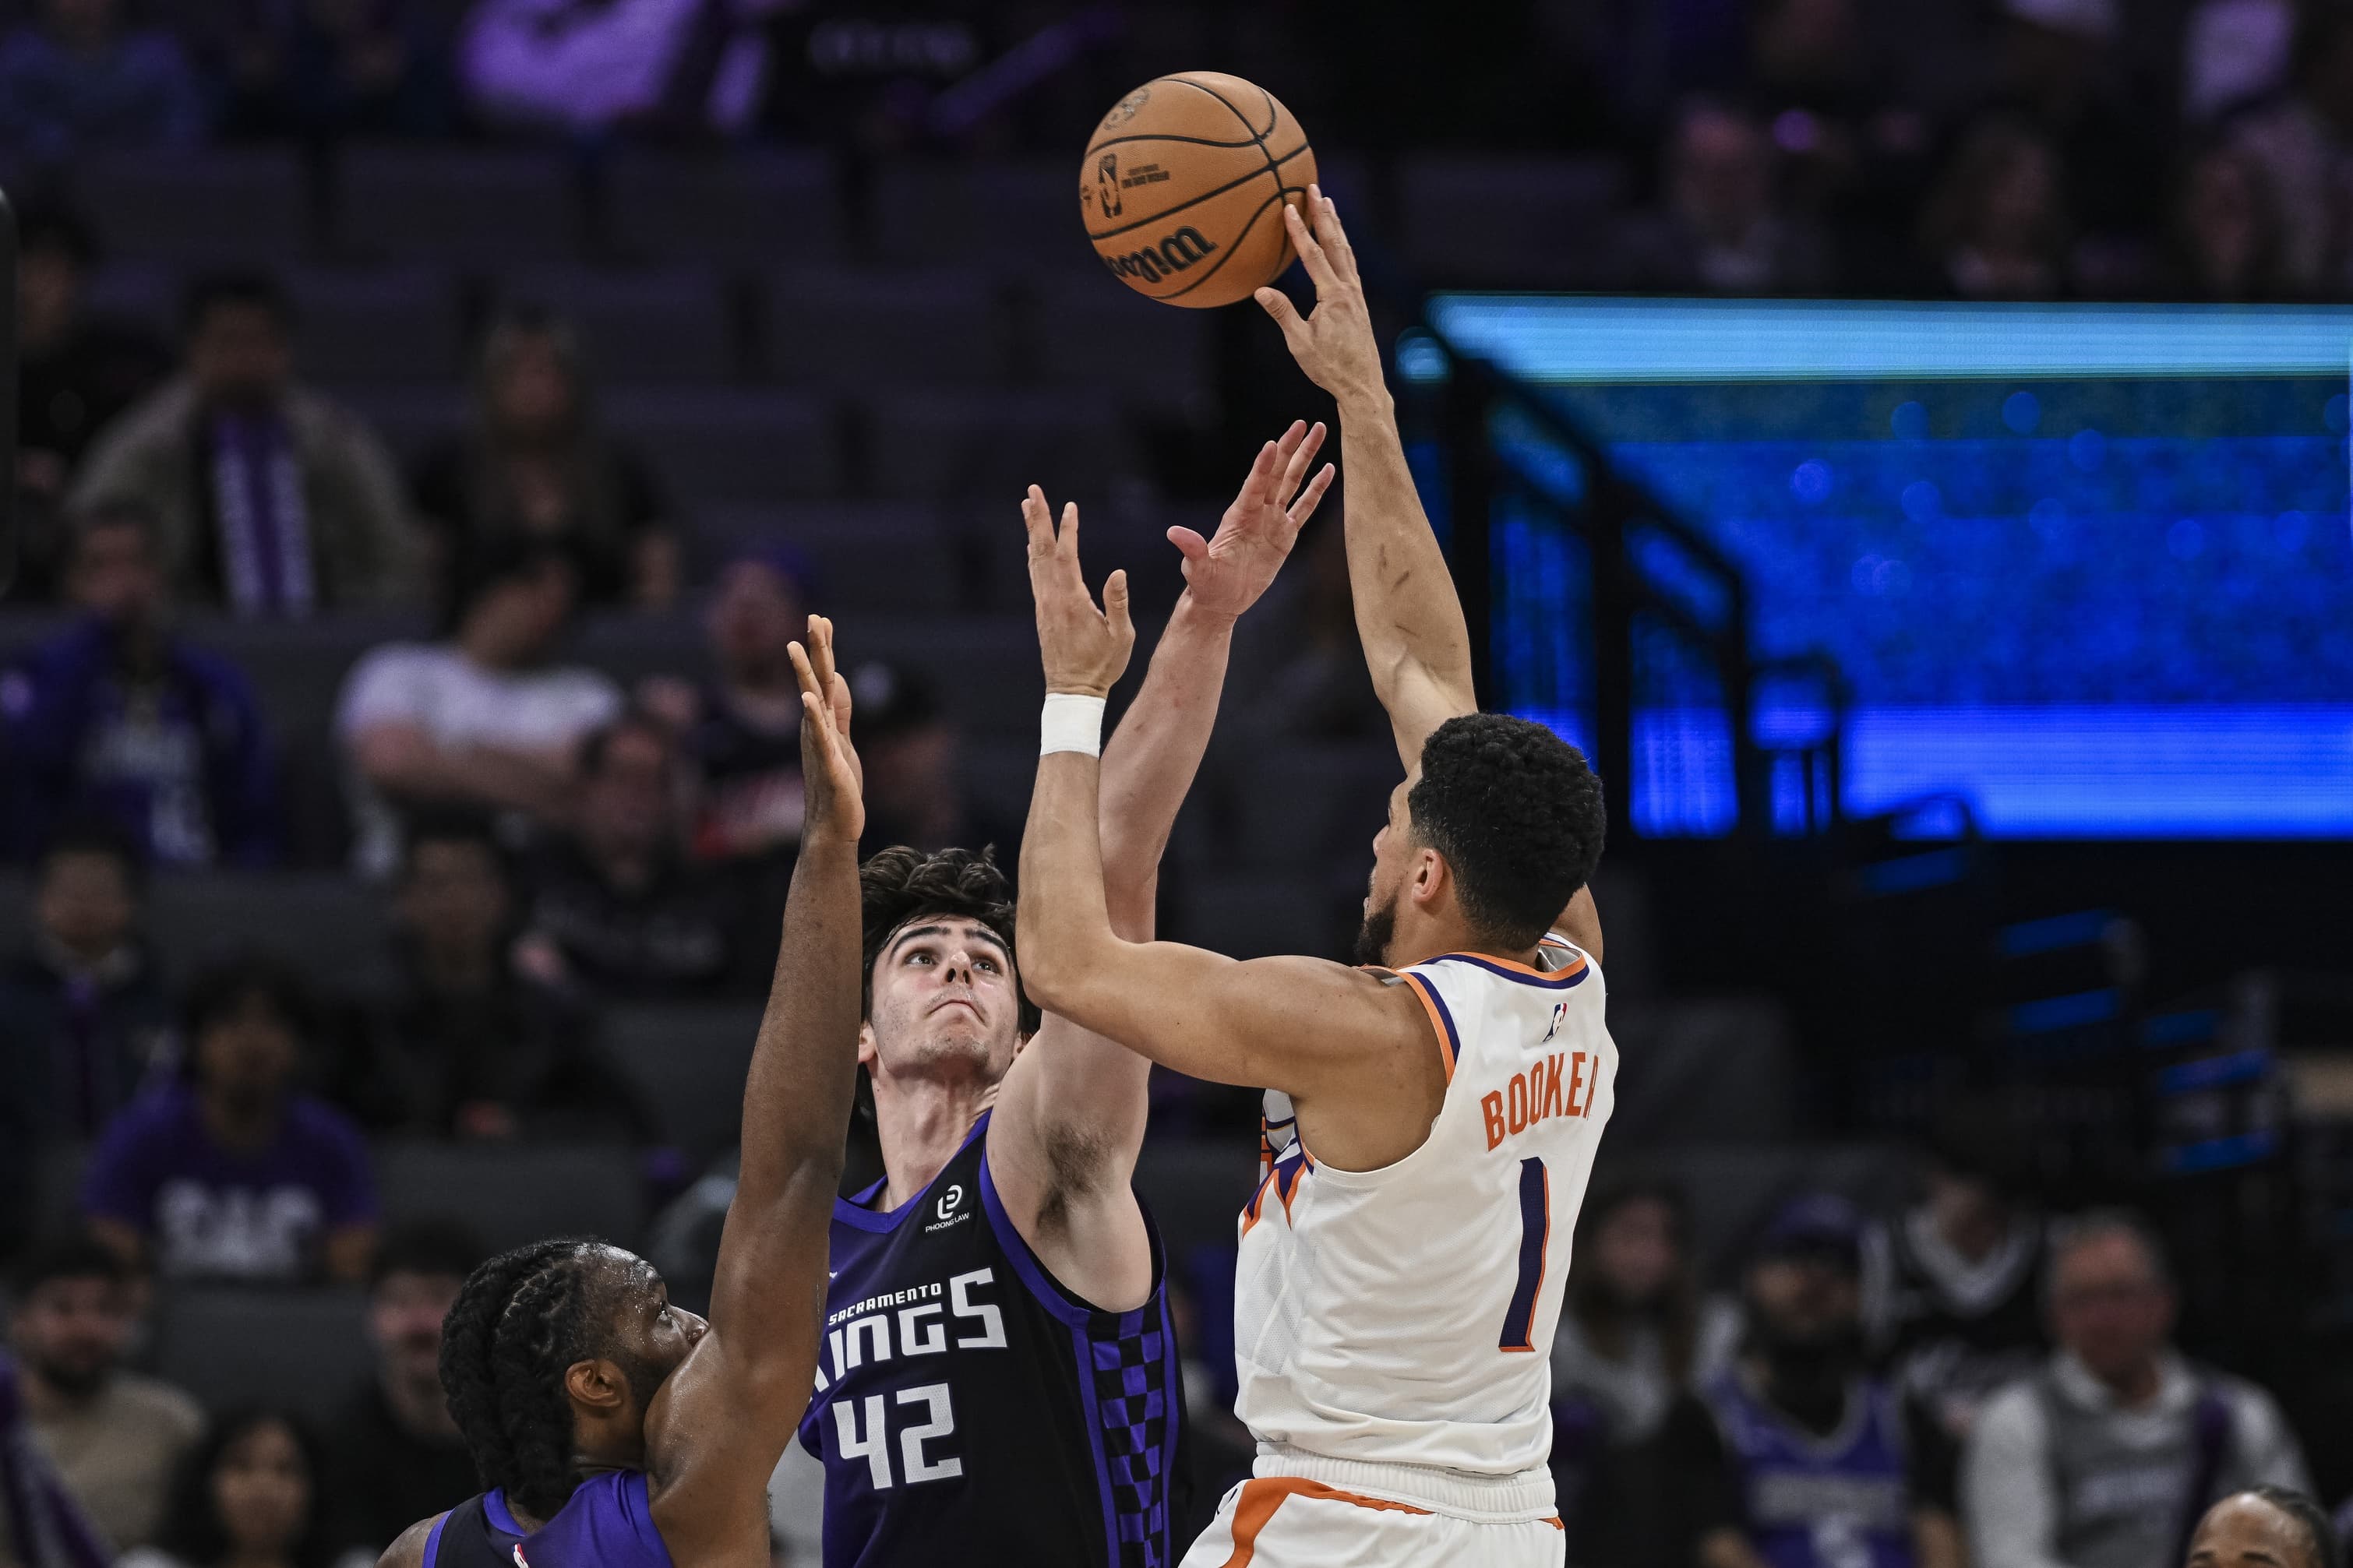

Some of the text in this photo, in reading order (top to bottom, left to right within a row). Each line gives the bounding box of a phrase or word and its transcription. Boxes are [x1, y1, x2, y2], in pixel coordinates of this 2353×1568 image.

[1104, 226, 1218, 284] Wilso
[925, 1212, 969, 1233] PHOONG LAW
[1498, 1156, 1550, 1352] 1
[810, 1267, 1008, 1402] INGS
[828, 1282, 942, 1326] SACRAMENTO
[832, 1383, 963, 1490] 42
